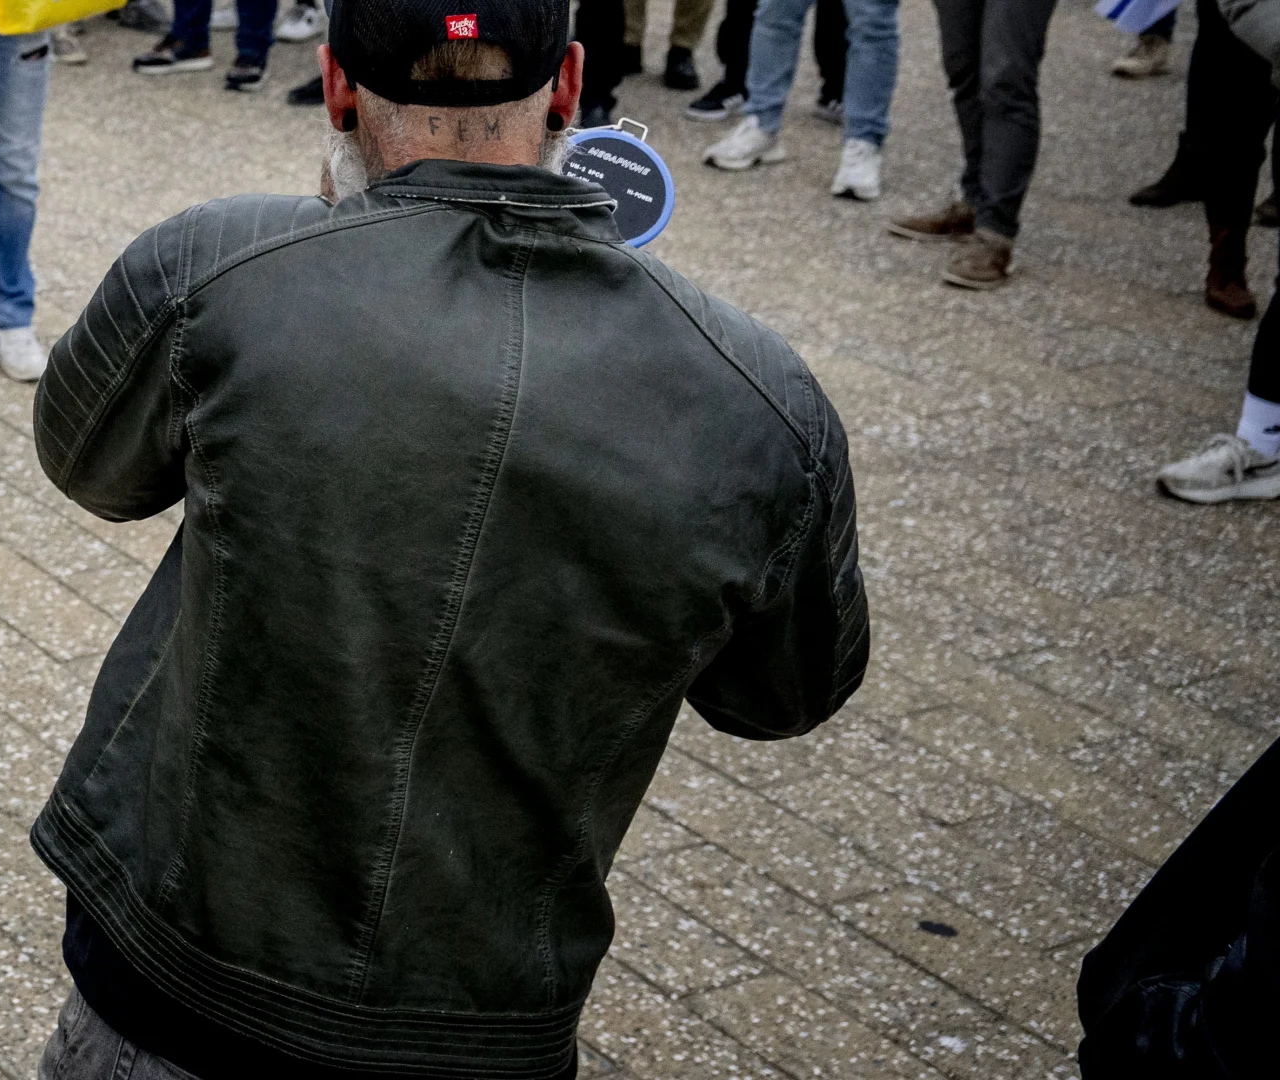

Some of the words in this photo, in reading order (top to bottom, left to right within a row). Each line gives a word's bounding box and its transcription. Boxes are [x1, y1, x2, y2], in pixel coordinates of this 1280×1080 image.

[450, 17, 475, 32] Lucky
[459, 26, 469, 36] 13
[587, 146, 652, 176] MEGAPHONE
[626, 188, 654, 203] HI-POWER
